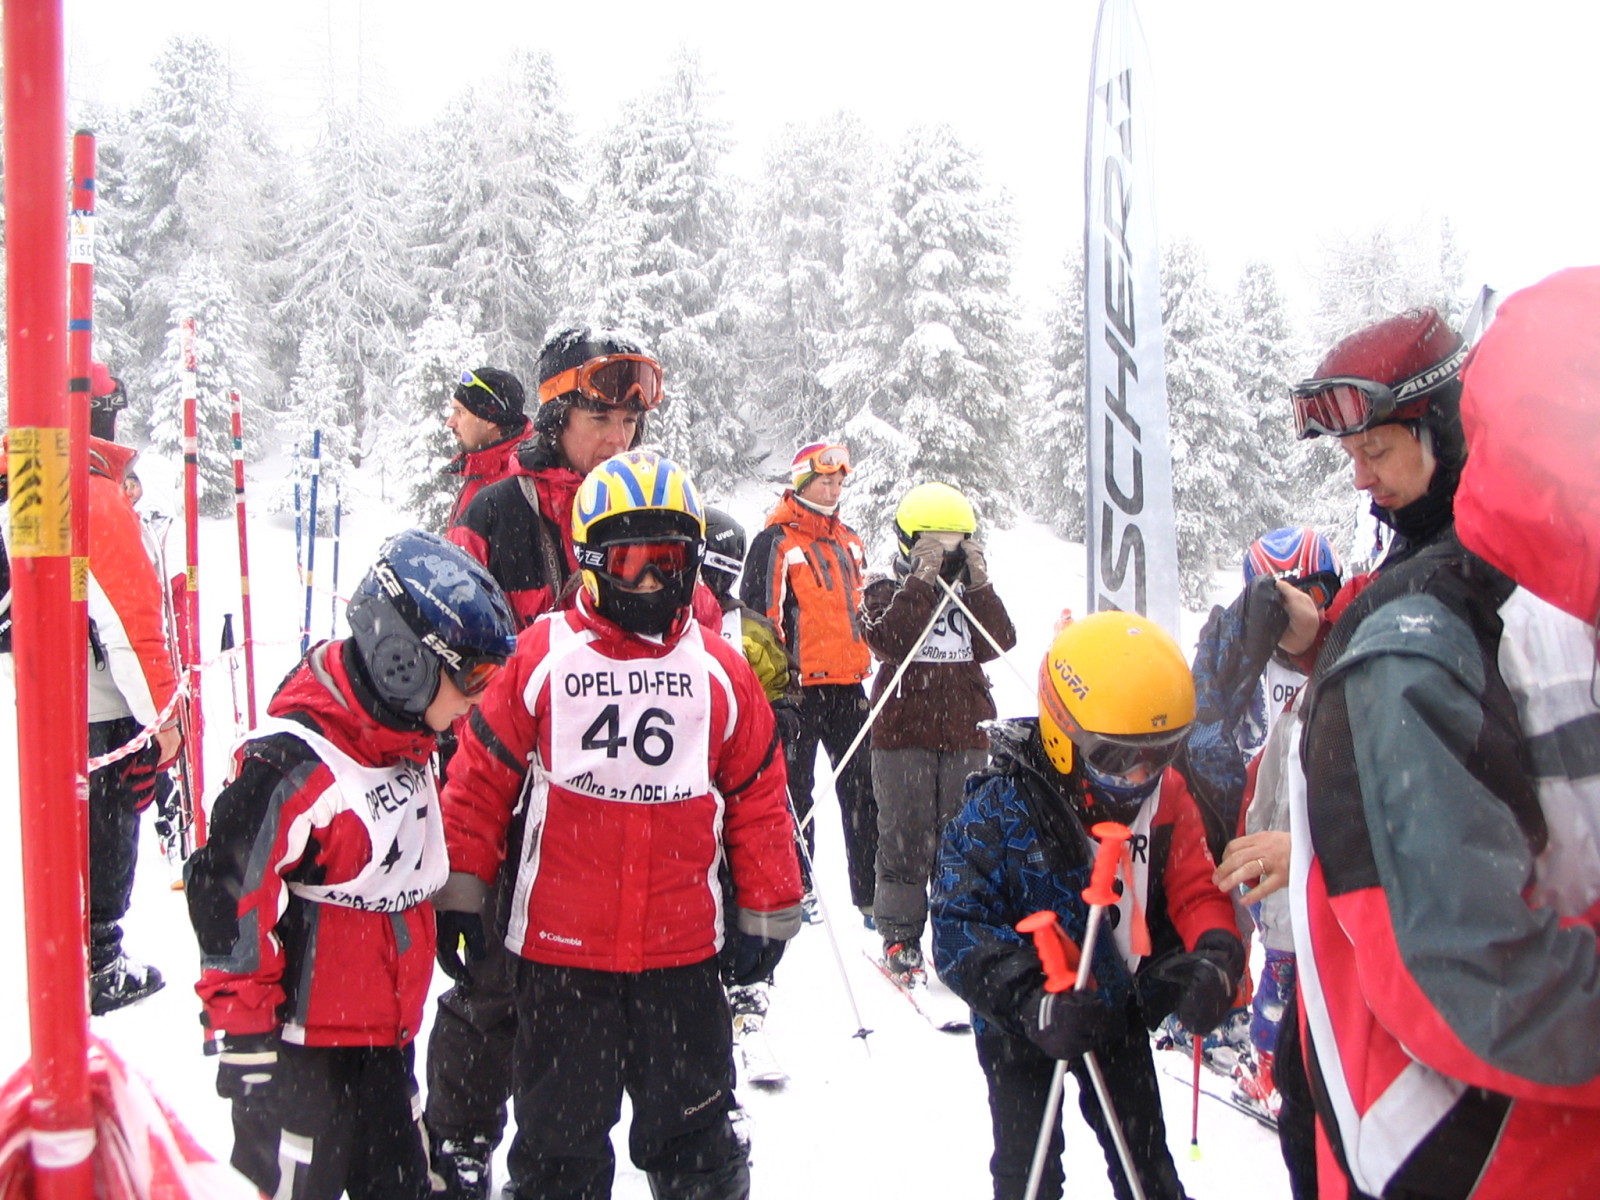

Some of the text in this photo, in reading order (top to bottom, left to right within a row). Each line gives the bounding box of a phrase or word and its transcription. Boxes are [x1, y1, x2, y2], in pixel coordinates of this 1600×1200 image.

[1098, 155, 1147, 618] SCHER
[565, 670, 693, 698] OPEL DI-FER
[1273, 684, 1296, 703] OP
[582, 704, 675, 766] 46
[547, 933, 582, 947] Columbia
